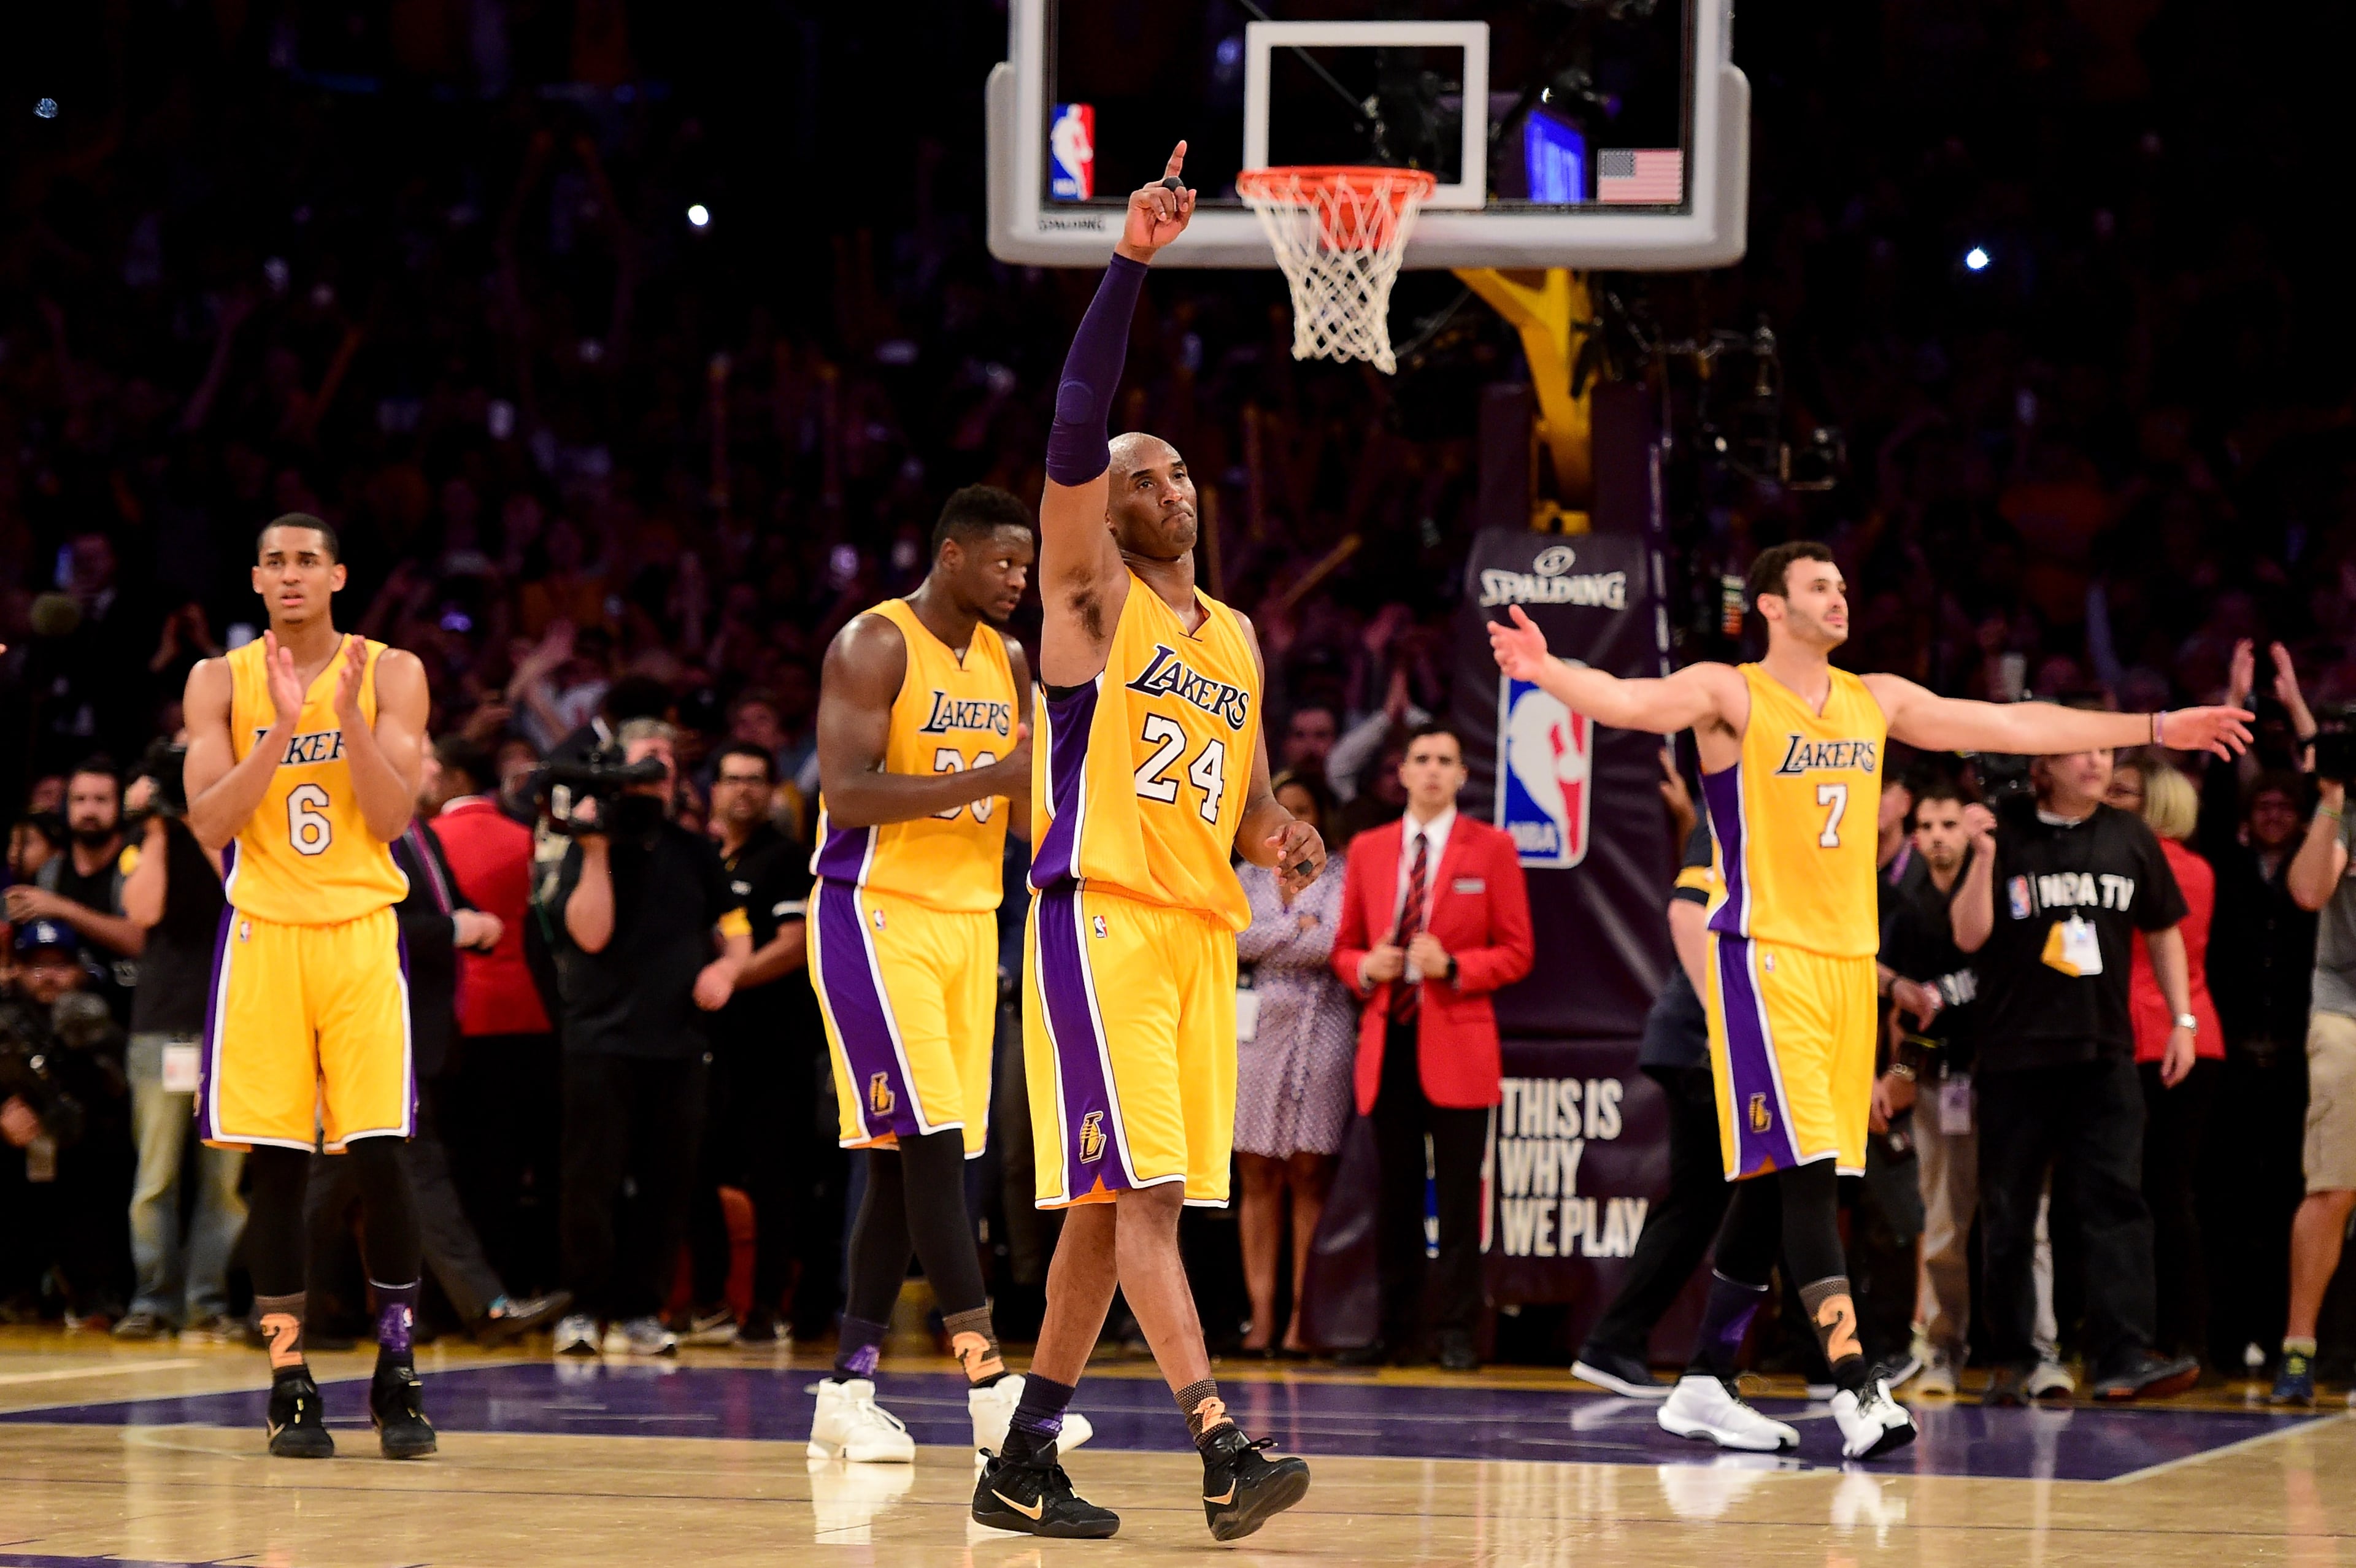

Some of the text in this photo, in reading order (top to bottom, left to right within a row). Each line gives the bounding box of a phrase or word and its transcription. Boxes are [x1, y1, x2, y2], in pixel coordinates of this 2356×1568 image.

[1479, 569, 1626, 611] SPALDING
[918, 690, 1012, 736] LAKERS
[1125, 643, 1250, 731] LAKERS
[1134, 712, 1225, 826] 24
[1773, 732, 1877, 775] LAKERS
[286, 783, 332, 856] 6
[1817, 783, 1847, 848] 7
[2038, 872, 2135, 912] NBA TV
[1498, 1077, 1623, 1140] THIS IS
[1498, 1137, 1585, 1197] WHY
[1499, 1196, 1650, 1258] WE PLAY
